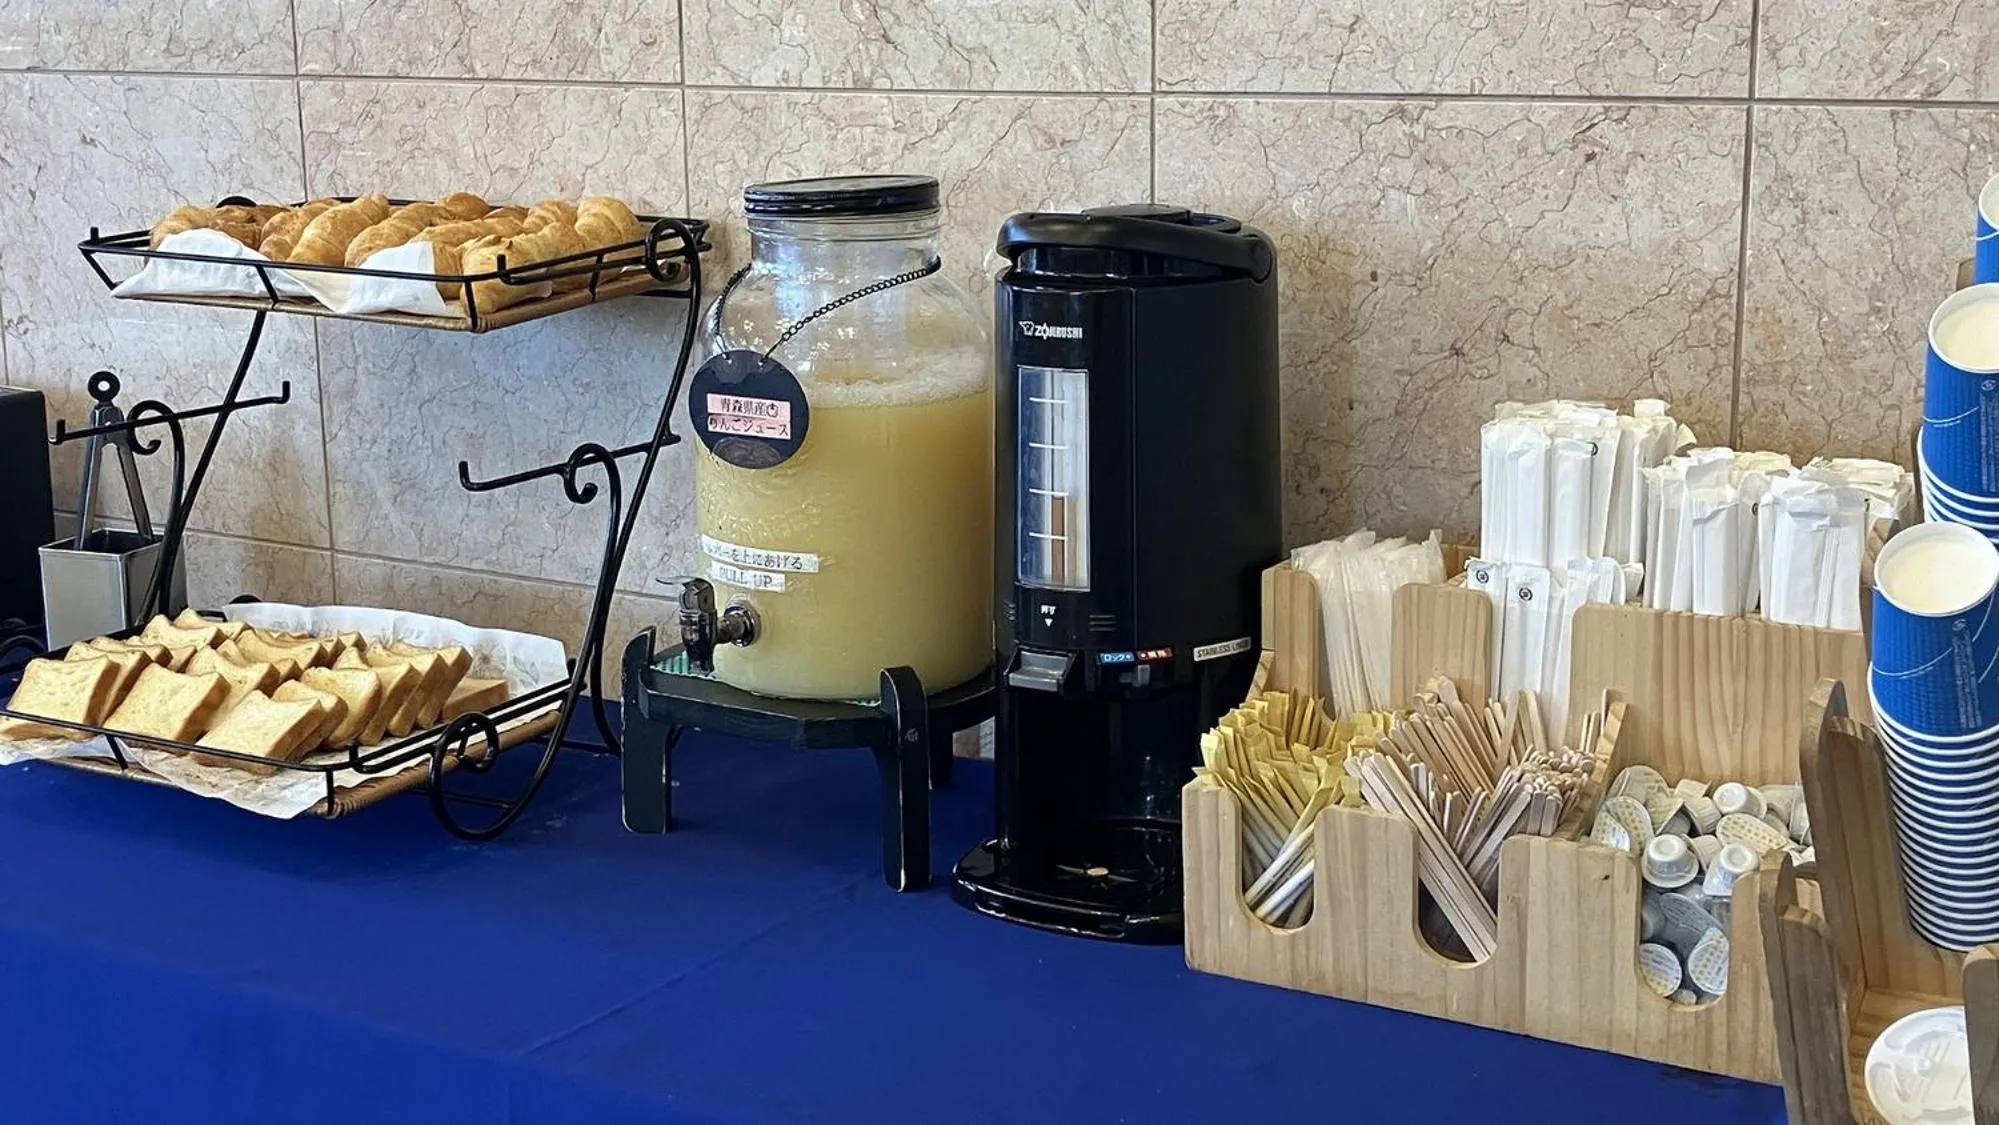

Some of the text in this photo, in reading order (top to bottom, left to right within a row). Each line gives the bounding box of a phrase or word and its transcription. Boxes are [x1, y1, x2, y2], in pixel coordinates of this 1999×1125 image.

[721, 398, 767, 417] 青森県産
[709, 418, 789, 436] りんごジュース
[719, 567, 773, 588] PULL UP
